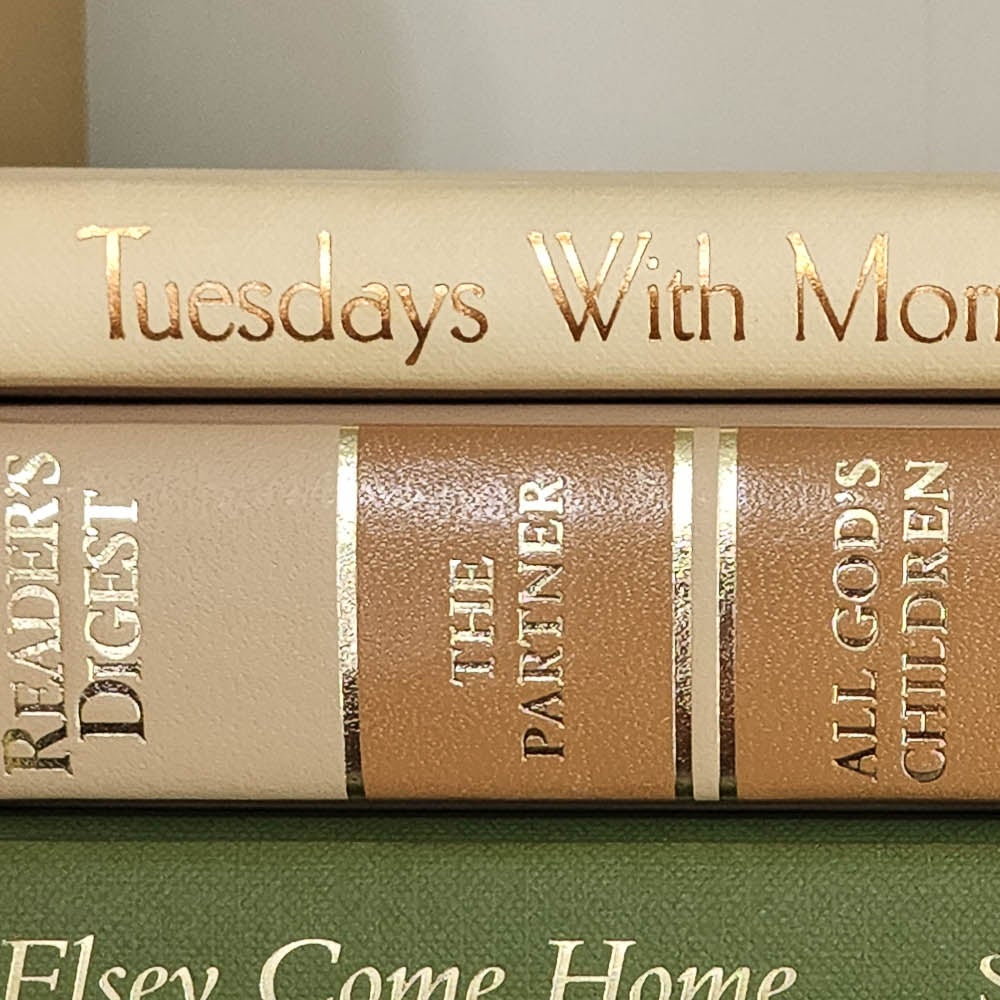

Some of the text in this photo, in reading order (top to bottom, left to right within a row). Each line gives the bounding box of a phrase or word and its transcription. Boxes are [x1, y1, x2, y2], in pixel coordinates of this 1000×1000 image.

[77, 225, 489, 366] Tuesdays
[526, 231, 746, 343] With
[2, 452, 74, 776] READER'S
[78, 489, 148, 744] DIGEST
[448, 555, 496, 687] THE
[517, 476, 566, 762] PARTNER
[831, 457, 882, 783] ALL GOD'S
[901, 459, 951, 783] CHILDREN
